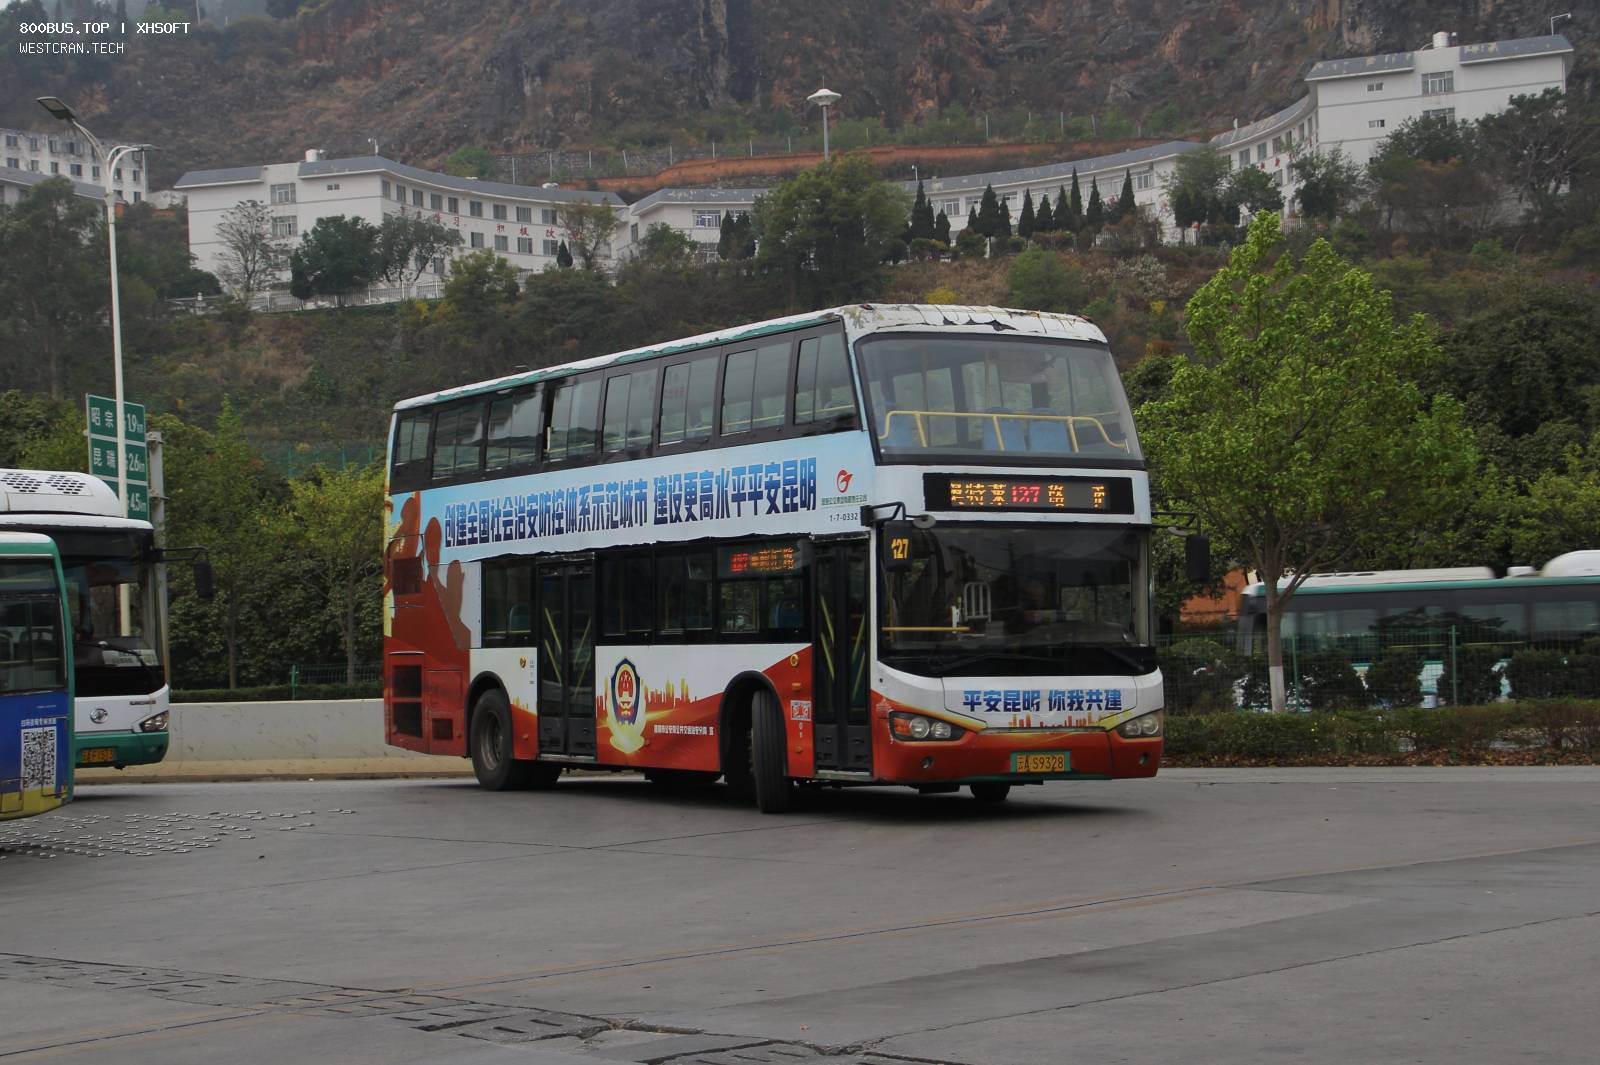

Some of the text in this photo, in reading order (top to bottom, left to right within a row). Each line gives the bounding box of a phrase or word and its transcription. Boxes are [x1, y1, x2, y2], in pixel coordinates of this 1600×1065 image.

[653, 457, 817, 525] 建设更高水平平安昆明
[891, 538, 909, 559] 127
[963, 689, 1122, 712] 平安昆明 你我共建
